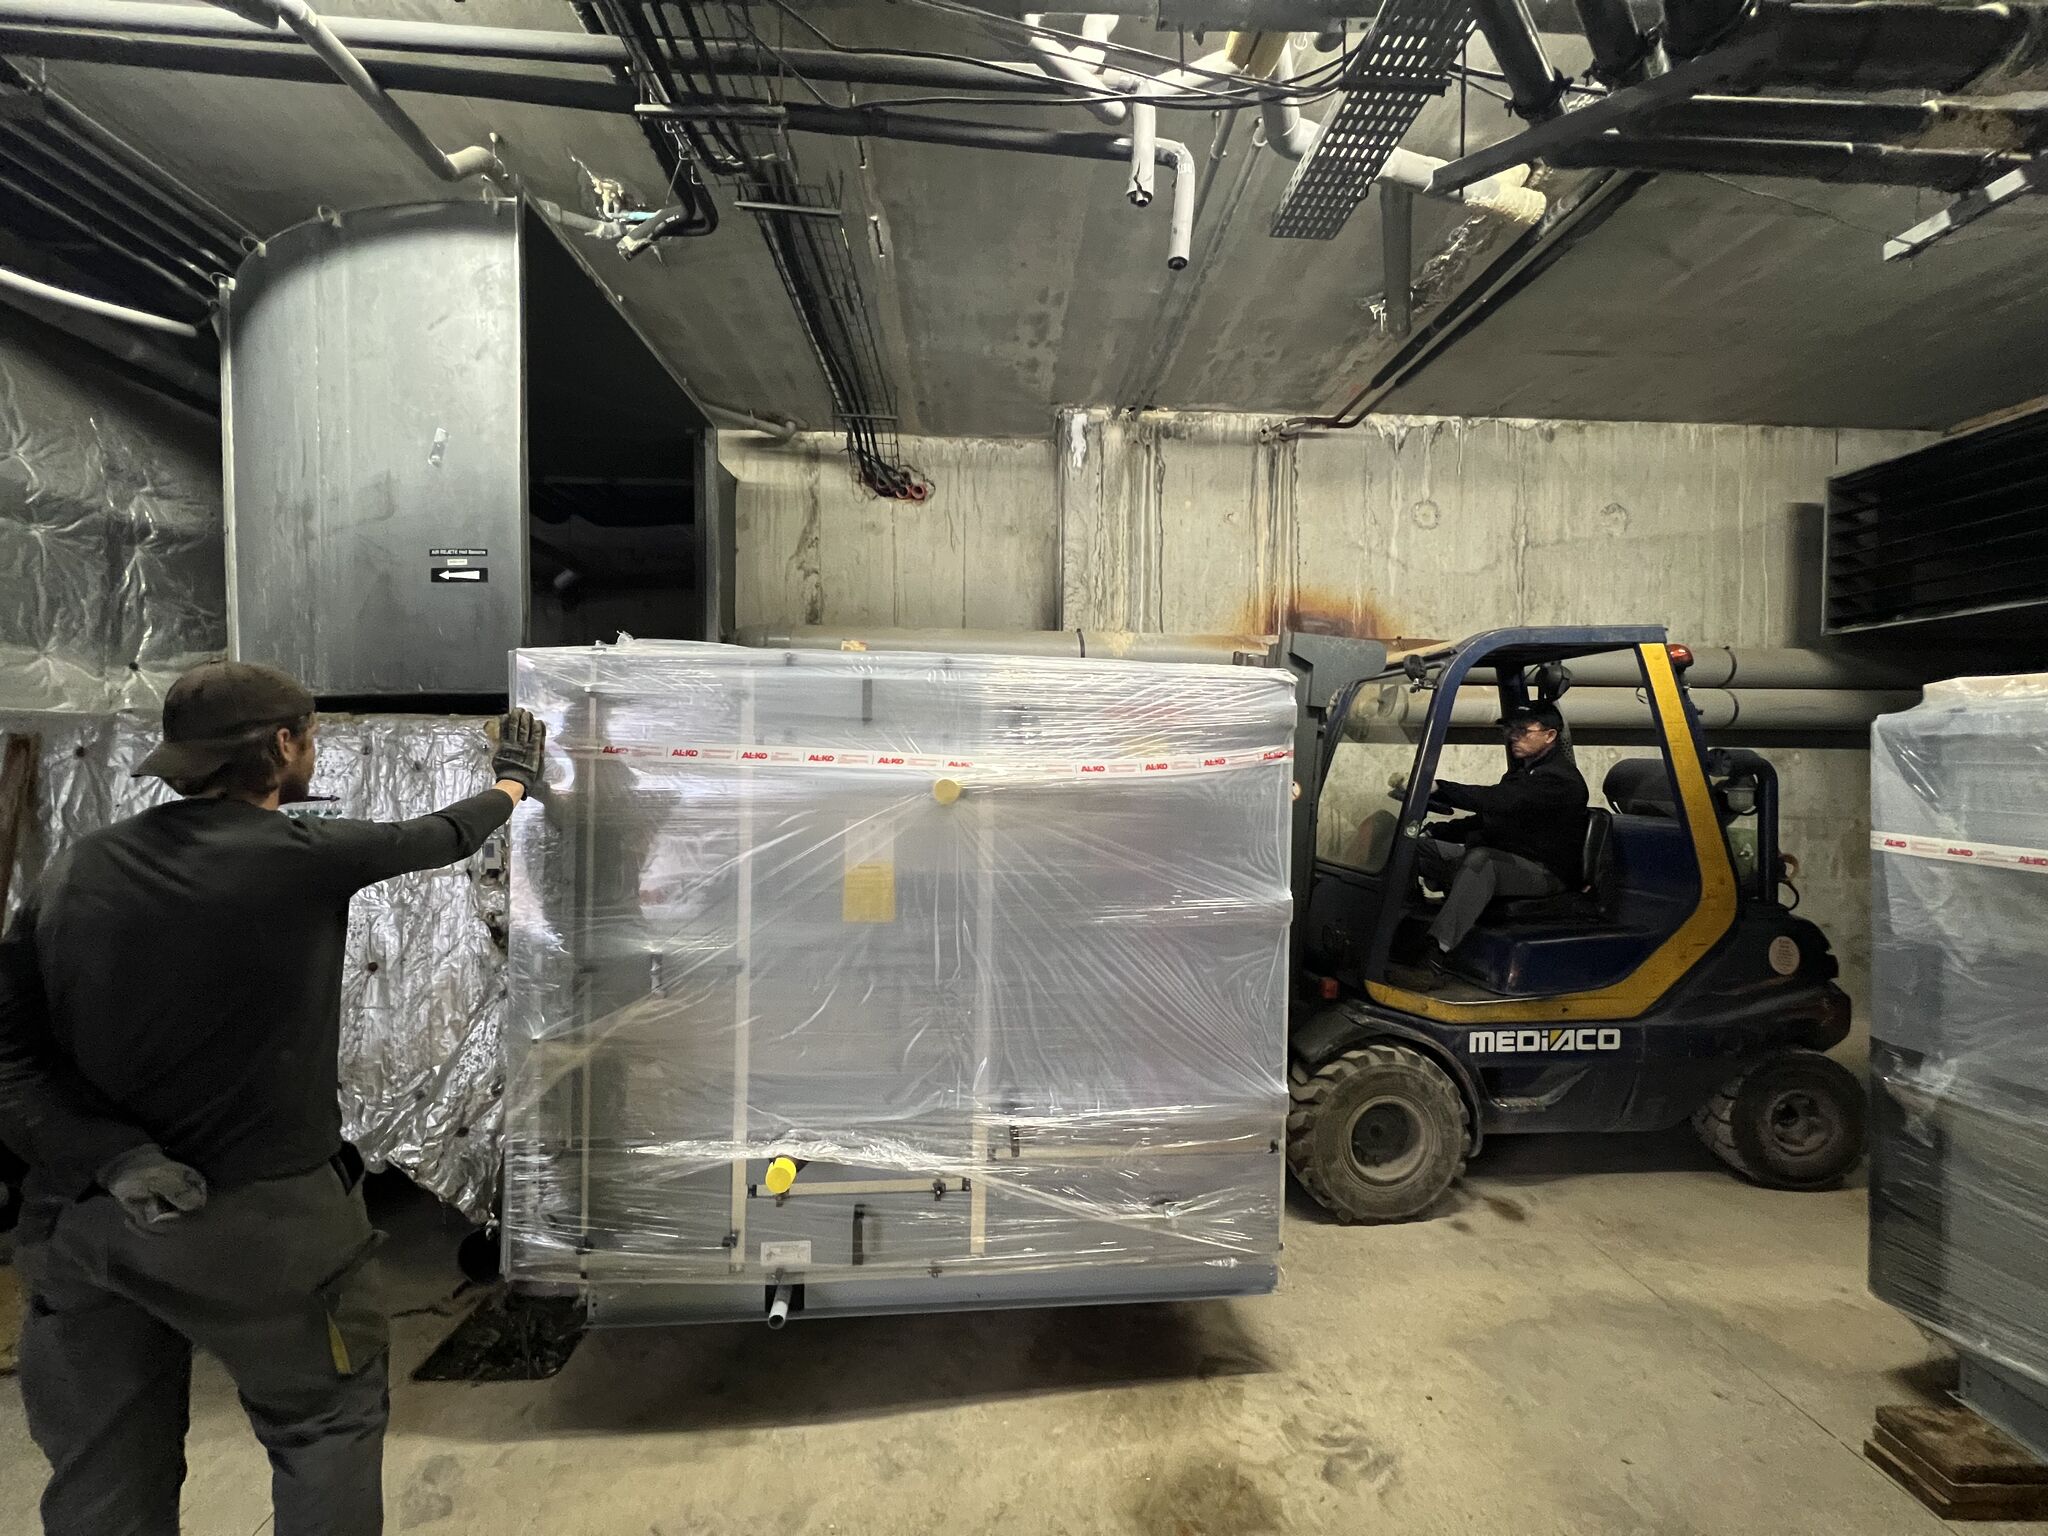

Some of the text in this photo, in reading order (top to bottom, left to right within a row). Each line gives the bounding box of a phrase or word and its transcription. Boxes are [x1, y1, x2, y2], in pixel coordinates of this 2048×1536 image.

[671, 749, 699, 757] AL-KO
[741, 751, 768, 760] AL-KO
[808, 754, 835, 762] AL-KO
[877, 757, 905, 765] AL-KO
[1081, 765, 1106, 773] AL-KO
[1145, 763, 1168, 771] AL-KO
[1204, 758, 1226, 766] AL-KO
